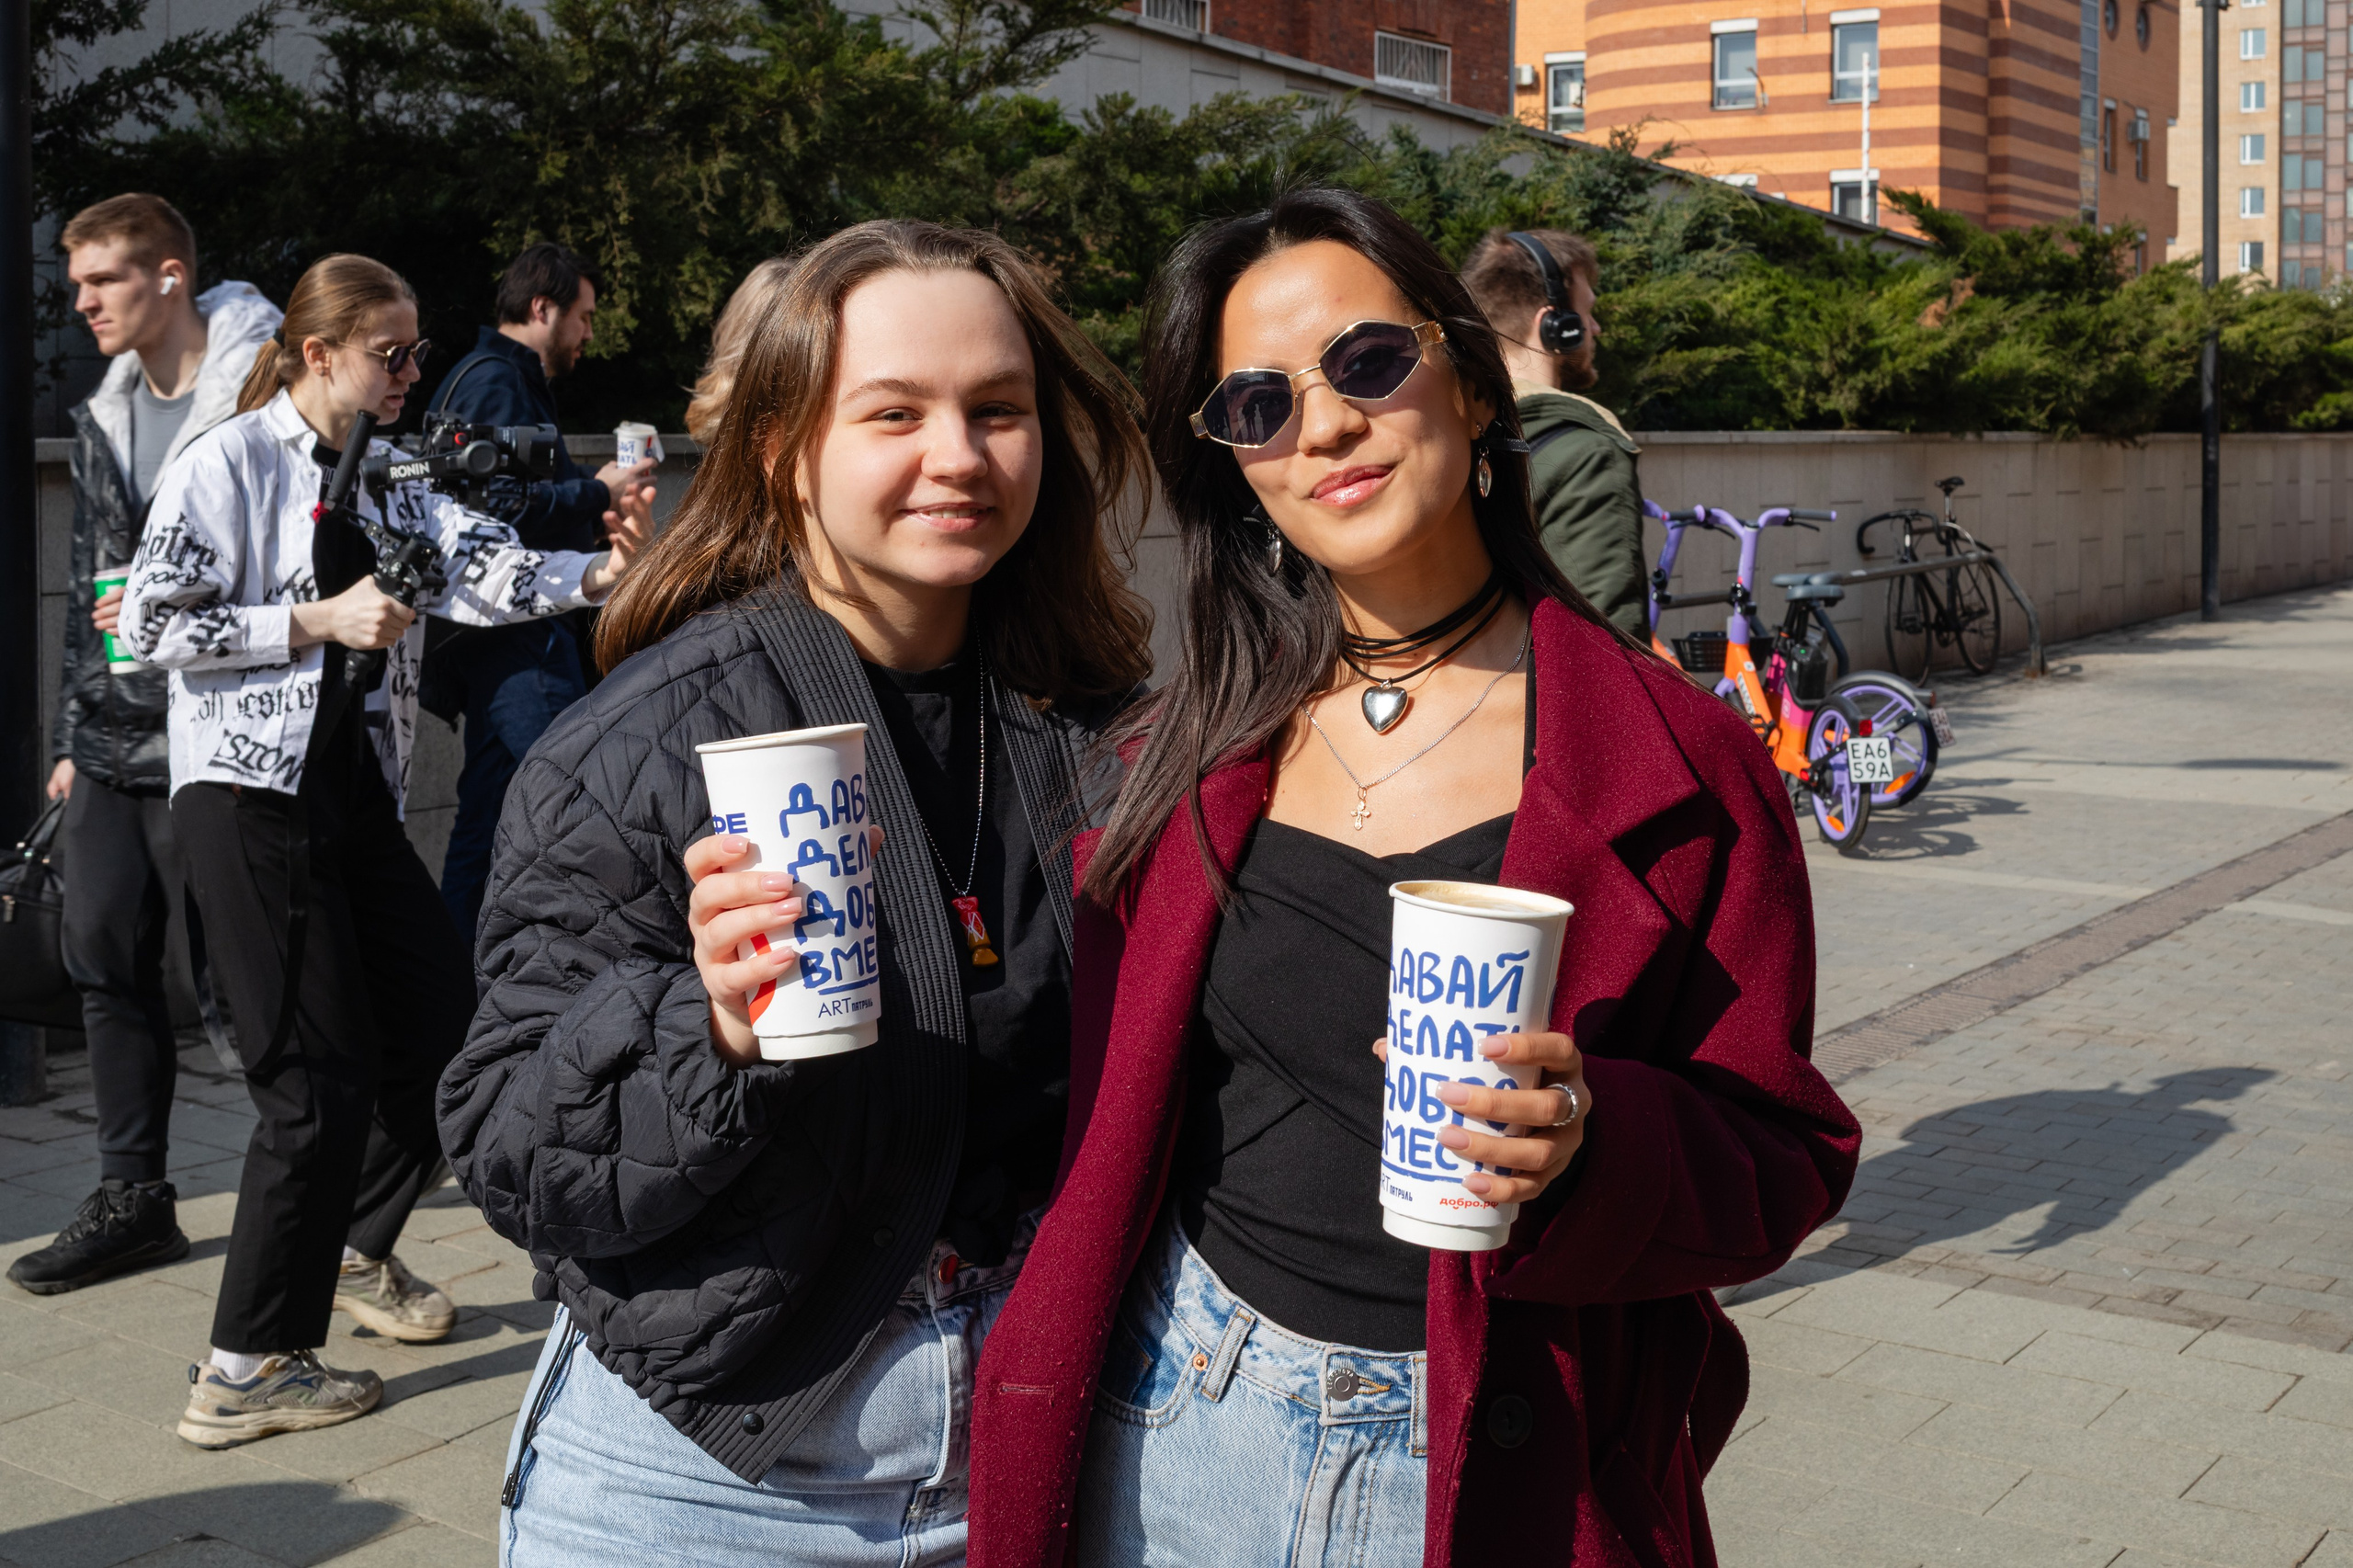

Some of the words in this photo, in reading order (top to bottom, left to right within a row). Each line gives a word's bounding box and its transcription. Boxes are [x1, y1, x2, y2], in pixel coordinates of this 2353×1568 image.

[390, 461, 430, 479] RONIN
[779, 773, 868, 838] ДАВ
[1388, 998, 1520, 1062] ЕЛАТ
[1439, 1197, 1499, 1210] добро.рф
